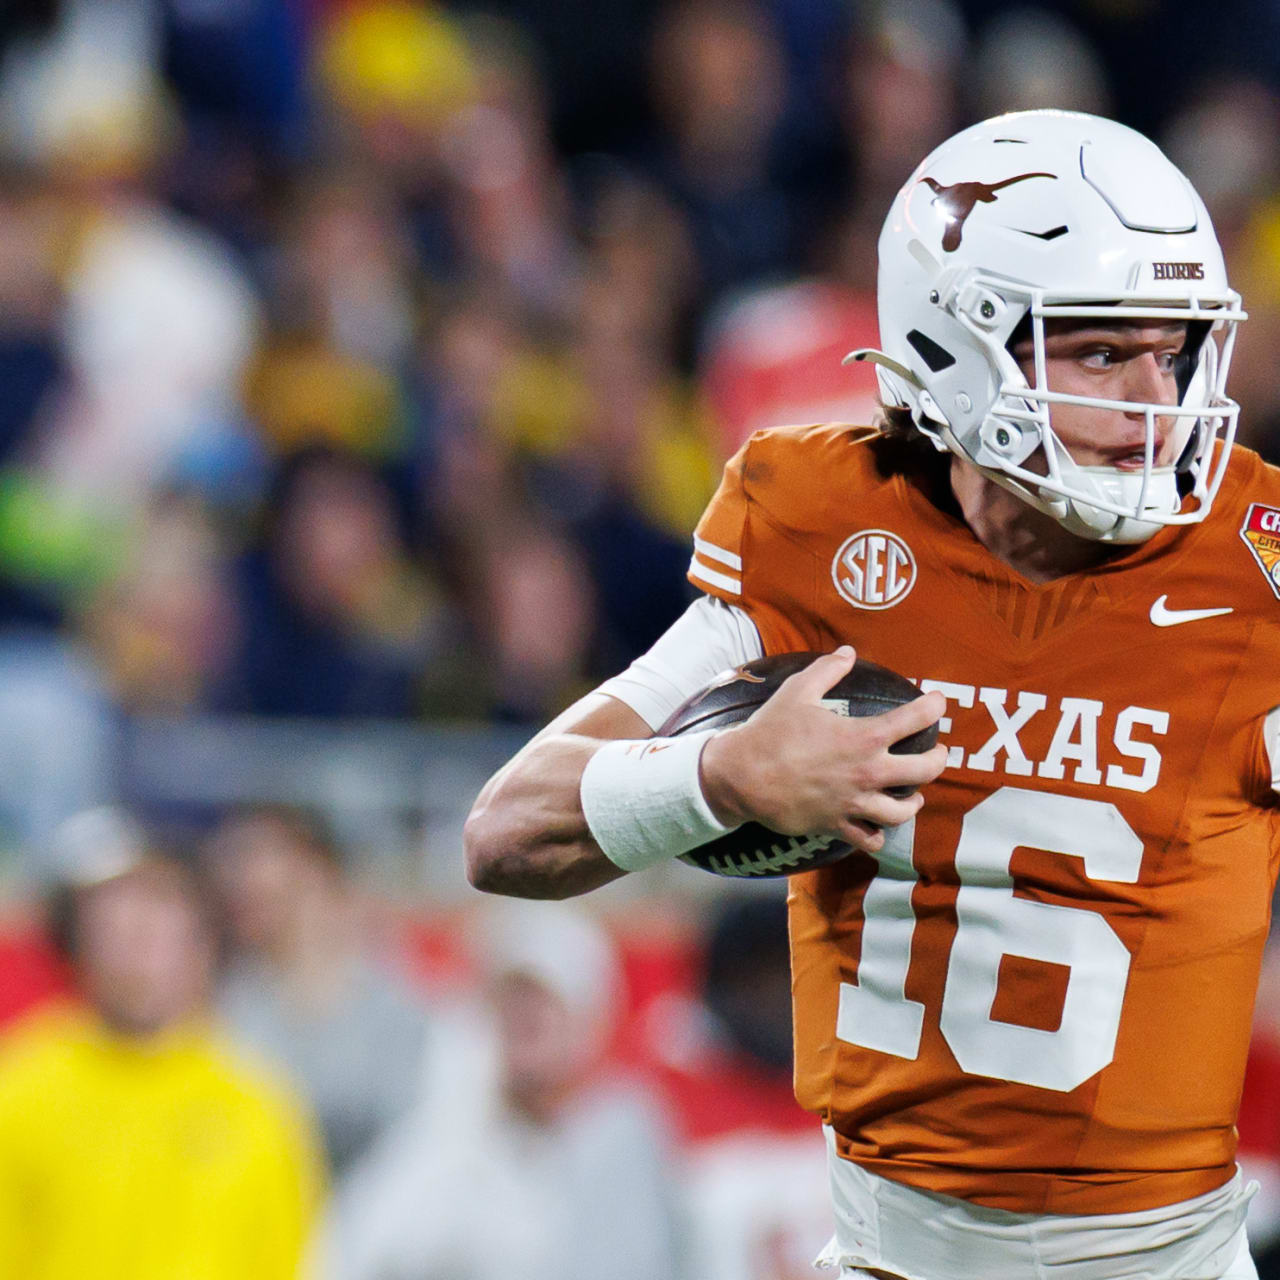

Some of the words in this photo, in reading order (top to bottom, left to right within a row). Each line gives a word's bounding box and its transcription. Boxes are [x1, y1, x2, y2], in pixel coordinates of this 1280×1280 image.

[1152, 262, 1205, 280] HORNS
[842, 535, 909, 603] SEC
[906, 677, 1170, 792] EXAS
[835, 785, 1144, 1093] 16
